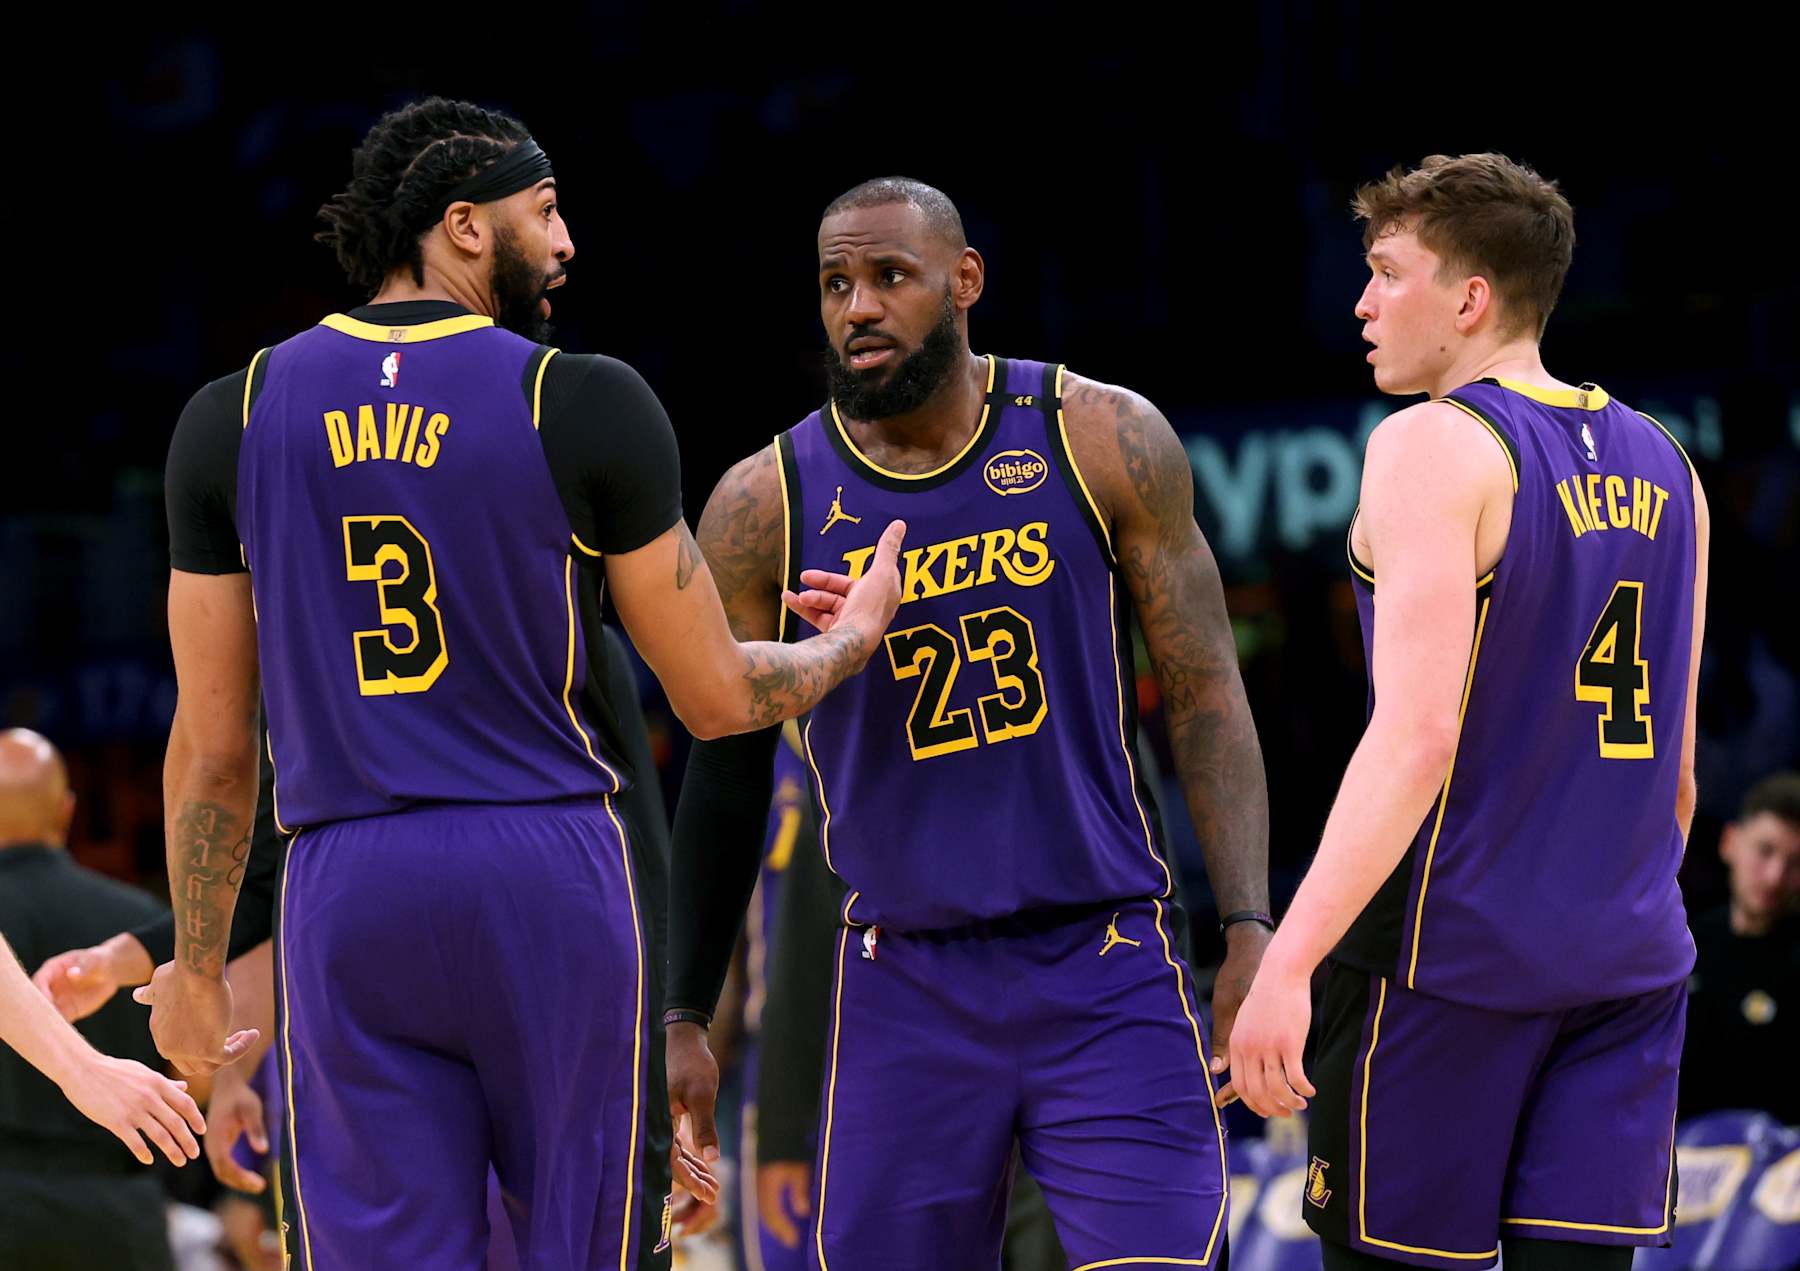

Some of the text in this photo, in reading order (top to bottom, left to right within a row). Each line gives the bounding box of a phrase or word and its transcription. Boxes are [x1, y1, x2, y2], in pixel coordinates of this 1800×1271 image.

[323, 402, 450, 469] DAVIS
[1015, 395, 1033, 407] 44
[989, 460, 1044, 480] bibigo
[1184, 410, 1376, 555] yp
[341, 515, 450, 697] 3
[842, 521, 1056, 606] KERS
[883, 605, 1049, 762] 23
[1574, 580, 1655, 760] 4
